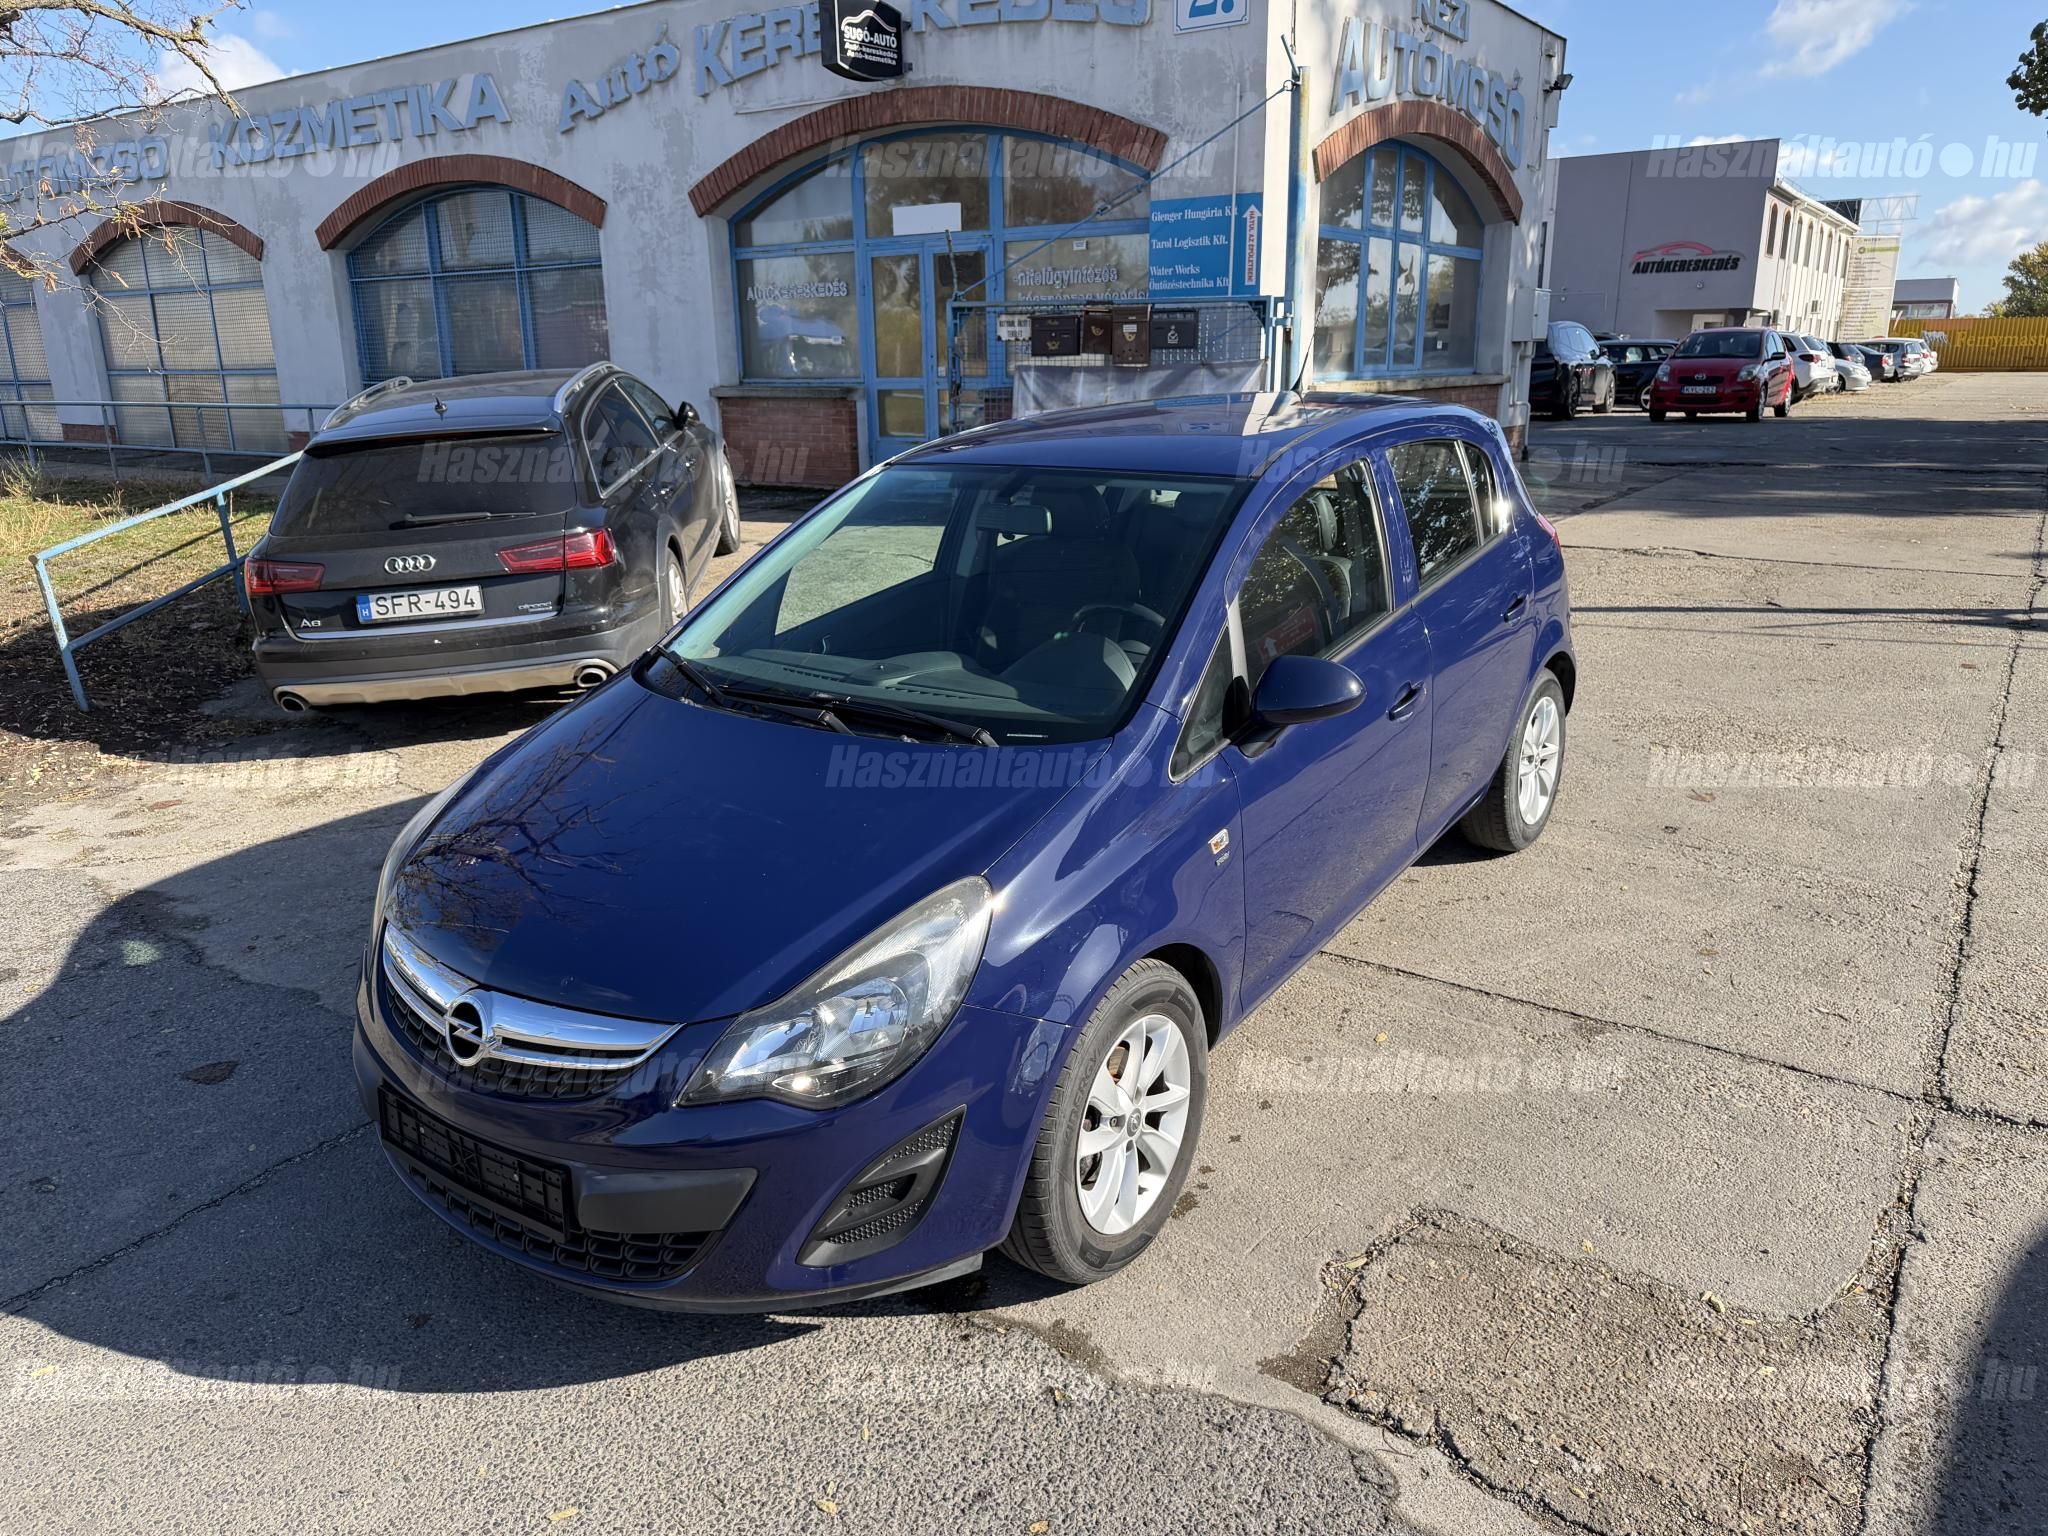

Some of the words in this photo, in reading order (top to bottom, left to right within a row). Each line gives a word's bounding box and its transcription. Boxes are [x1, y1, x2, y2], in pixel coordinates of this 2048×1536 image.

[559, 21, 681, 134] Autó
[1330, 16, 1526, 171] AUTÓMOSÓ
[208, 72, 513, 169] KOZMETIKA
[1151, 211, 1182, 223] Gienger
[1184, 207, 1223, 221] Hungária
[1225, 205, 1238, 216] Kt
[1151, 237, 1173, 249] Tarol
[1174, 236, 1211, 250] Logisztik
[1150, 266, 1174, 276] Water
[1175, 264, 1200, 275] Works
[1632, 255, 1740, 275] AUTÓKERESKEDÉS
[1149, 278, 1215, 291] Öntözéstechnika
[362, 608, 369, 617] H
[375, 589, 477, 616] SFR-494
[300, 618, 321, 628] A6
